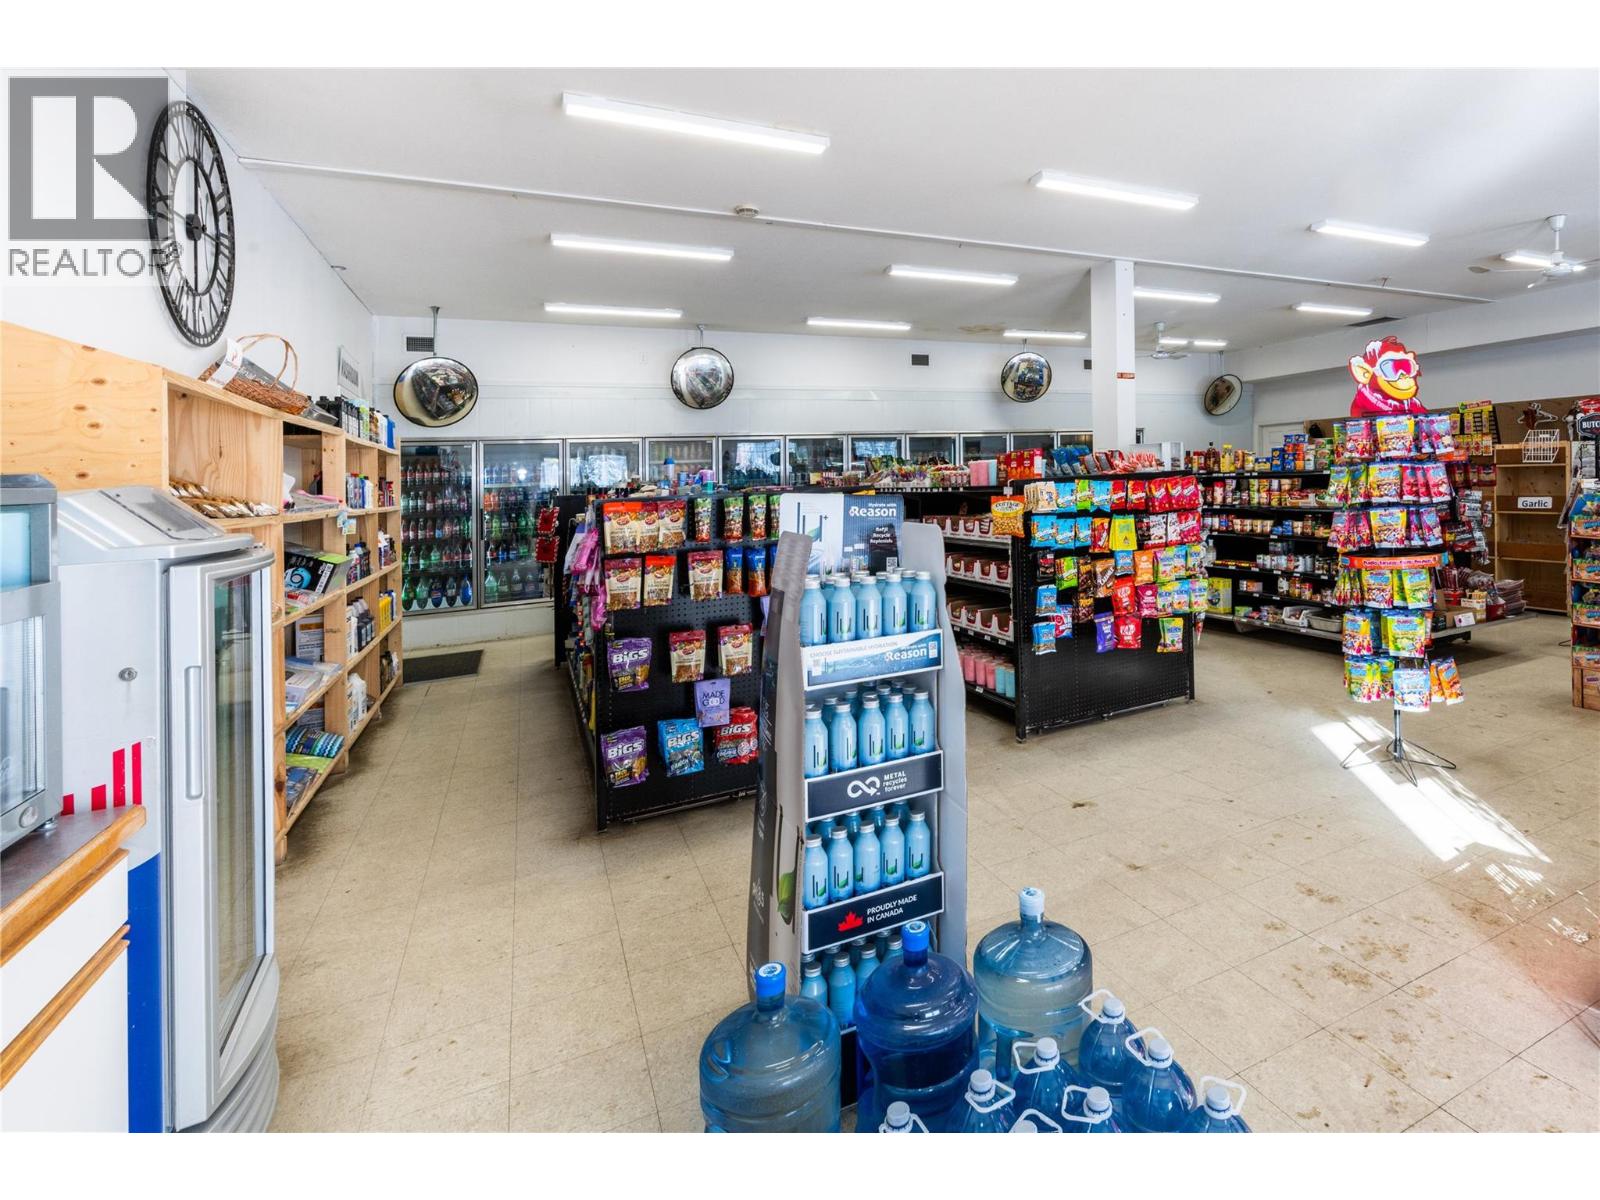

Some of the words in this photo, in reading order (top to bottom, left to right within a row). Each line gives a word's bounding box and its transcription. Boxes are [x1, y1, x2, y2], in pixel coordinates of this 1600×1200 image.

[1521, 499, 1549, 508] Garlic
[849, 506, 897, 517] Reason
[884, 648, 928, 661] Reason
[702, 690, 726, 699] MADE
[702, 697, 725, 707] GOOD
[884, 771, 906, 780] METAL
[883, 777, 908, 787] recycles
[884, 784, 906, 792] forever
[867, 900, 898, 915] PROUDLY
[897, 894, 918, 906] MADE
[867, 916, 875, 924] IN
[875, 907, 904, 921] CANADA
